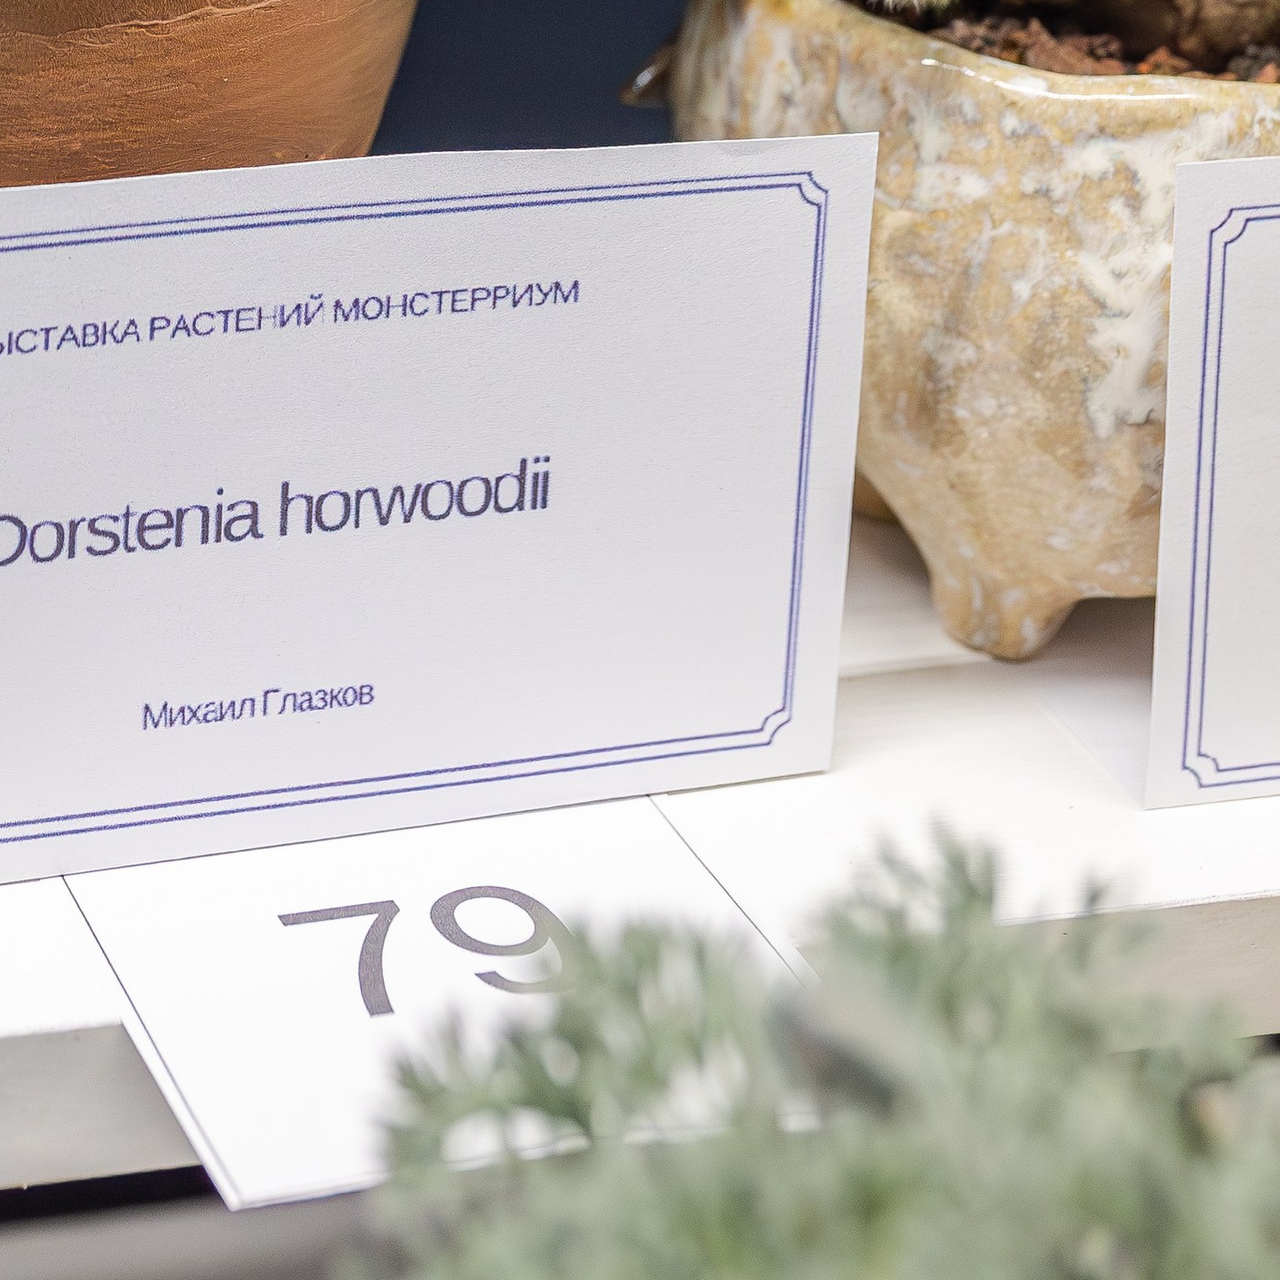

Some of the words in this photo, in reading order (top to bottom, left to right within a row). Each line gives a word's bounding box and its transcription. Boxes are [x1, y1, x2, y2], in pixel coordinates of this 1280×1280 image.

[148, 292, 325, 342] РАСТЕНИЙ
[332, 279, 580, 324] МОНСТЕРРИУМ
[278, 455, 552, 537] horwoodii
[141, 697, 256, 731] Михаил
[261, 683, 376, 719] Глазков
[277, 885, 578, 1017] 79
